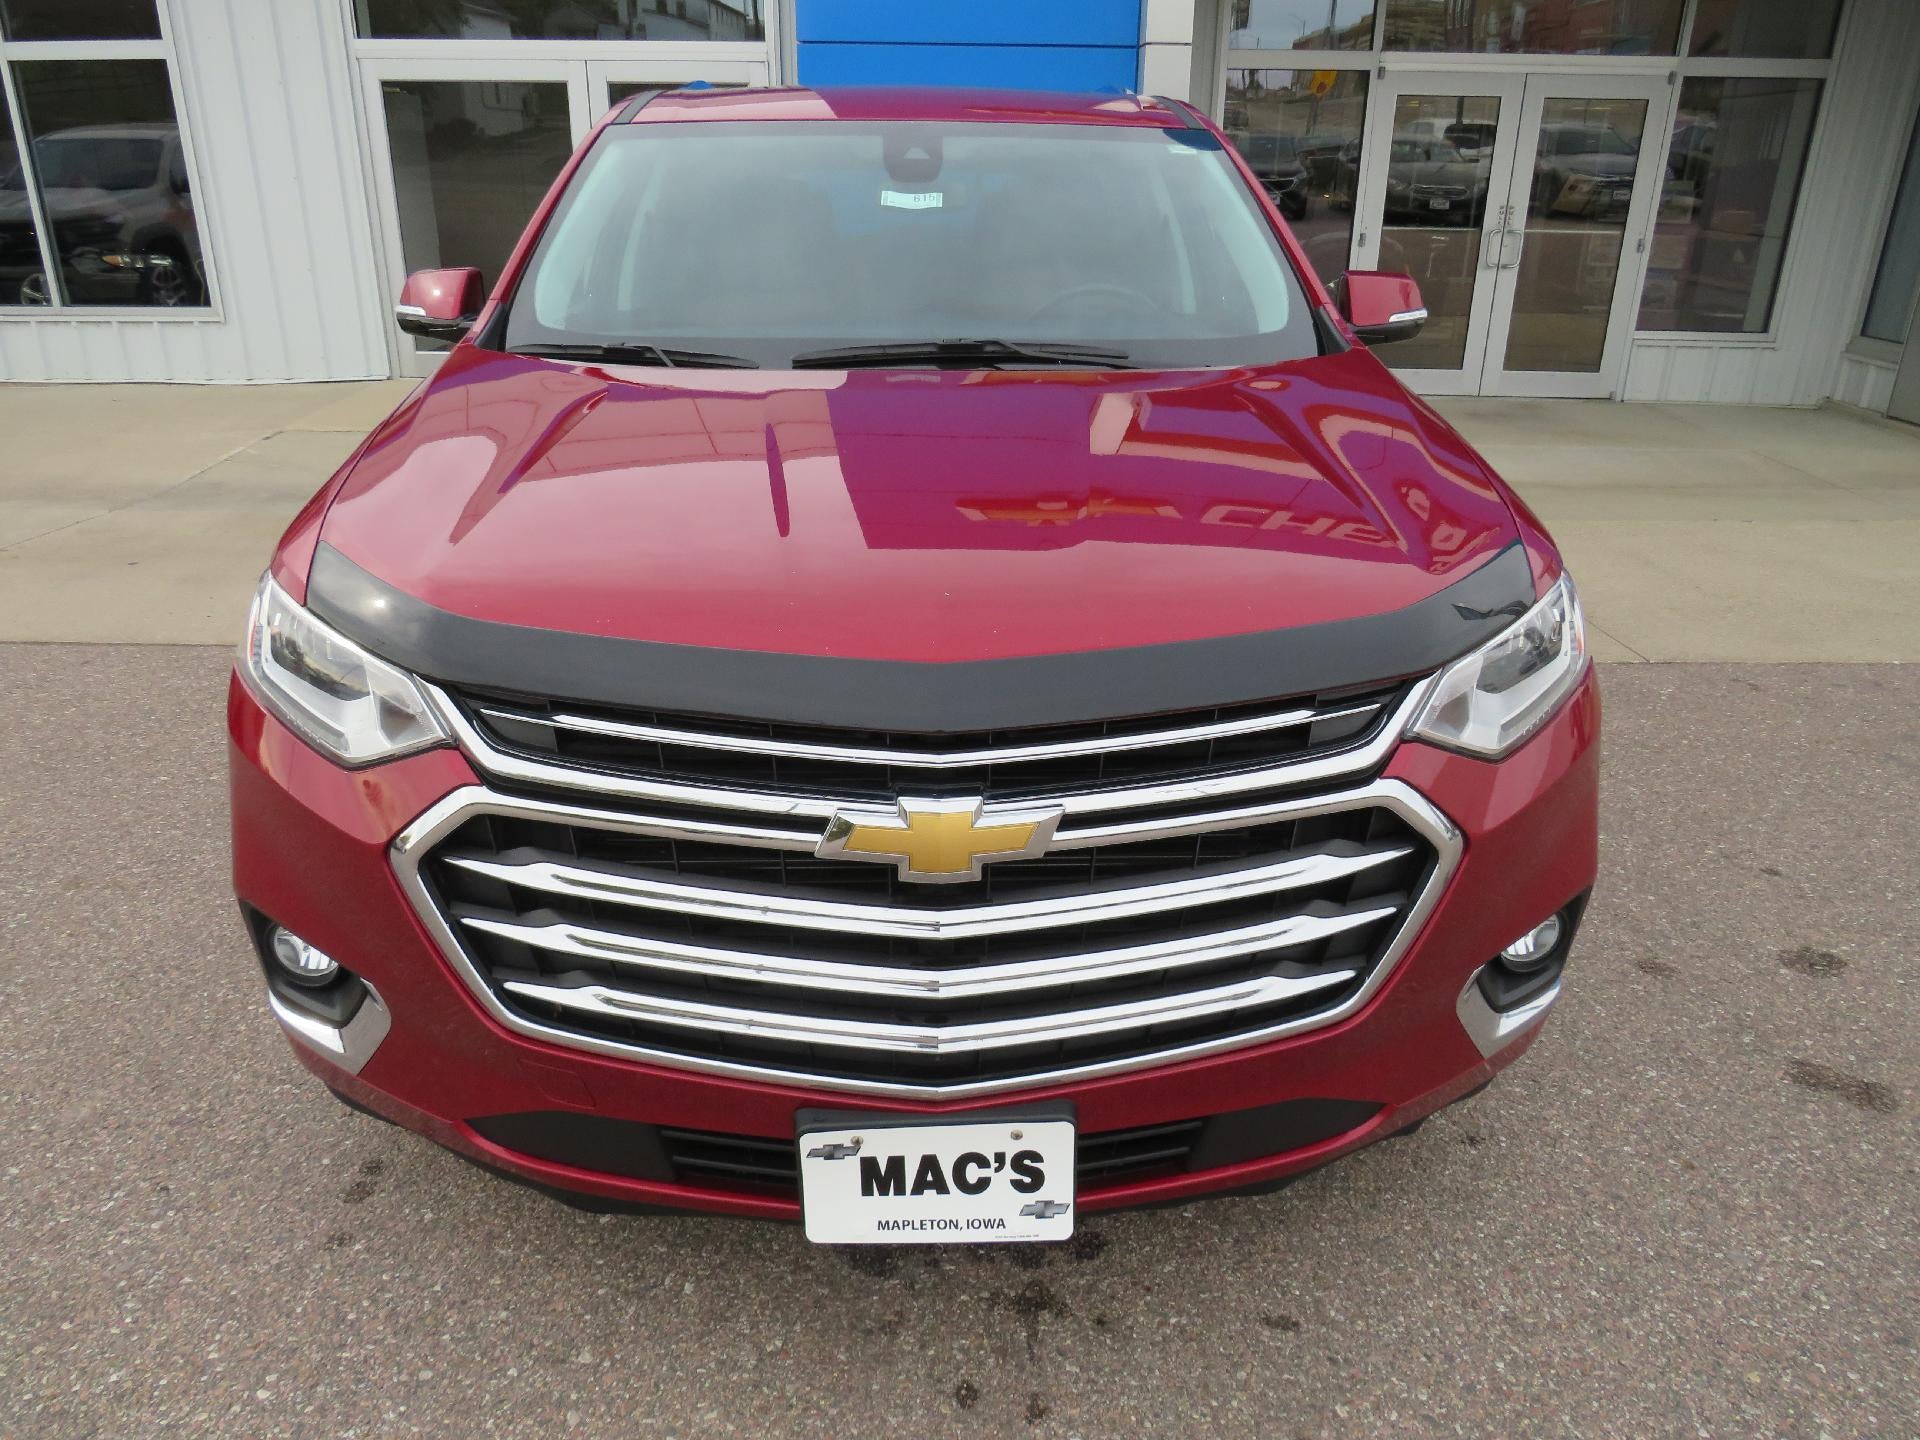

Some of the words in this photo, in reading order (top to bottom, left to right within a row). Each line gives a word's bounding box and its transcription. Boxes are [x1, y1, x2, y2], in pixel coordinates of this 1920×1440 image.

[860, 1150, 1045, 1197] MAC'S
[877, 1219, 963, 1231] MAPLETON,
[966, 1218, 1006, 1230] IOWA
